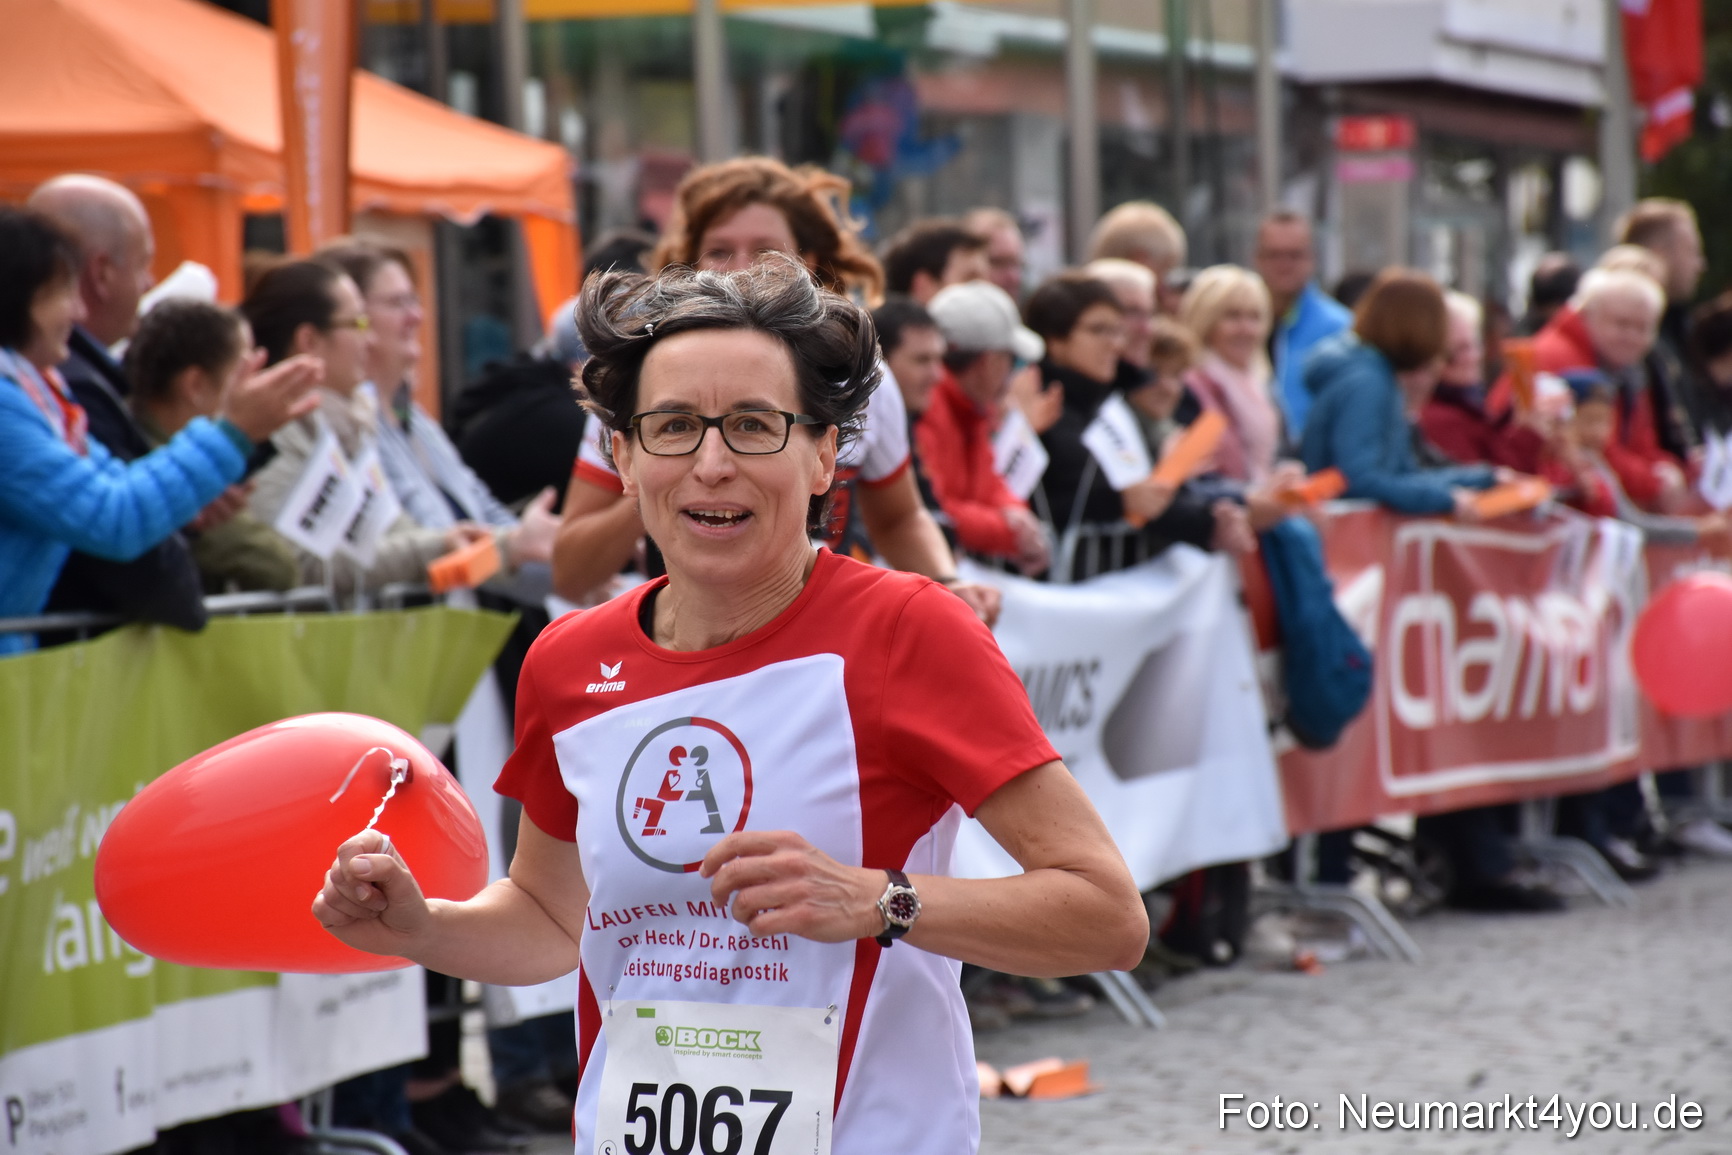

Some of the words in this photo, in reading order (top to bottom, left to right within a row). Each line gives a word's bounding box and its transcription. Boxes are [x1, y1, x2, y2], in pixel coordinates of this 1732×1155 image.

[585, 681, 626, 694] erima
[587, 902, 678, 931] LAUFEN
[618, 933, 643, 948] Dr.
[645, 929, 685, 946] Heck
[699, 933, 724, 949] Dr.
[728, 935, 789, 951] Röschl
[623, 957, 789, 985] Leistungsdiagnostik
[674, 1026, 762, 1052] BOCK
[673, 1048, 701, 1057] inspired
[702, 1050, 710, 1058] by
[733, 1052, 763, 1060] concepts
[624, 1082, 793, 1155] 5067
